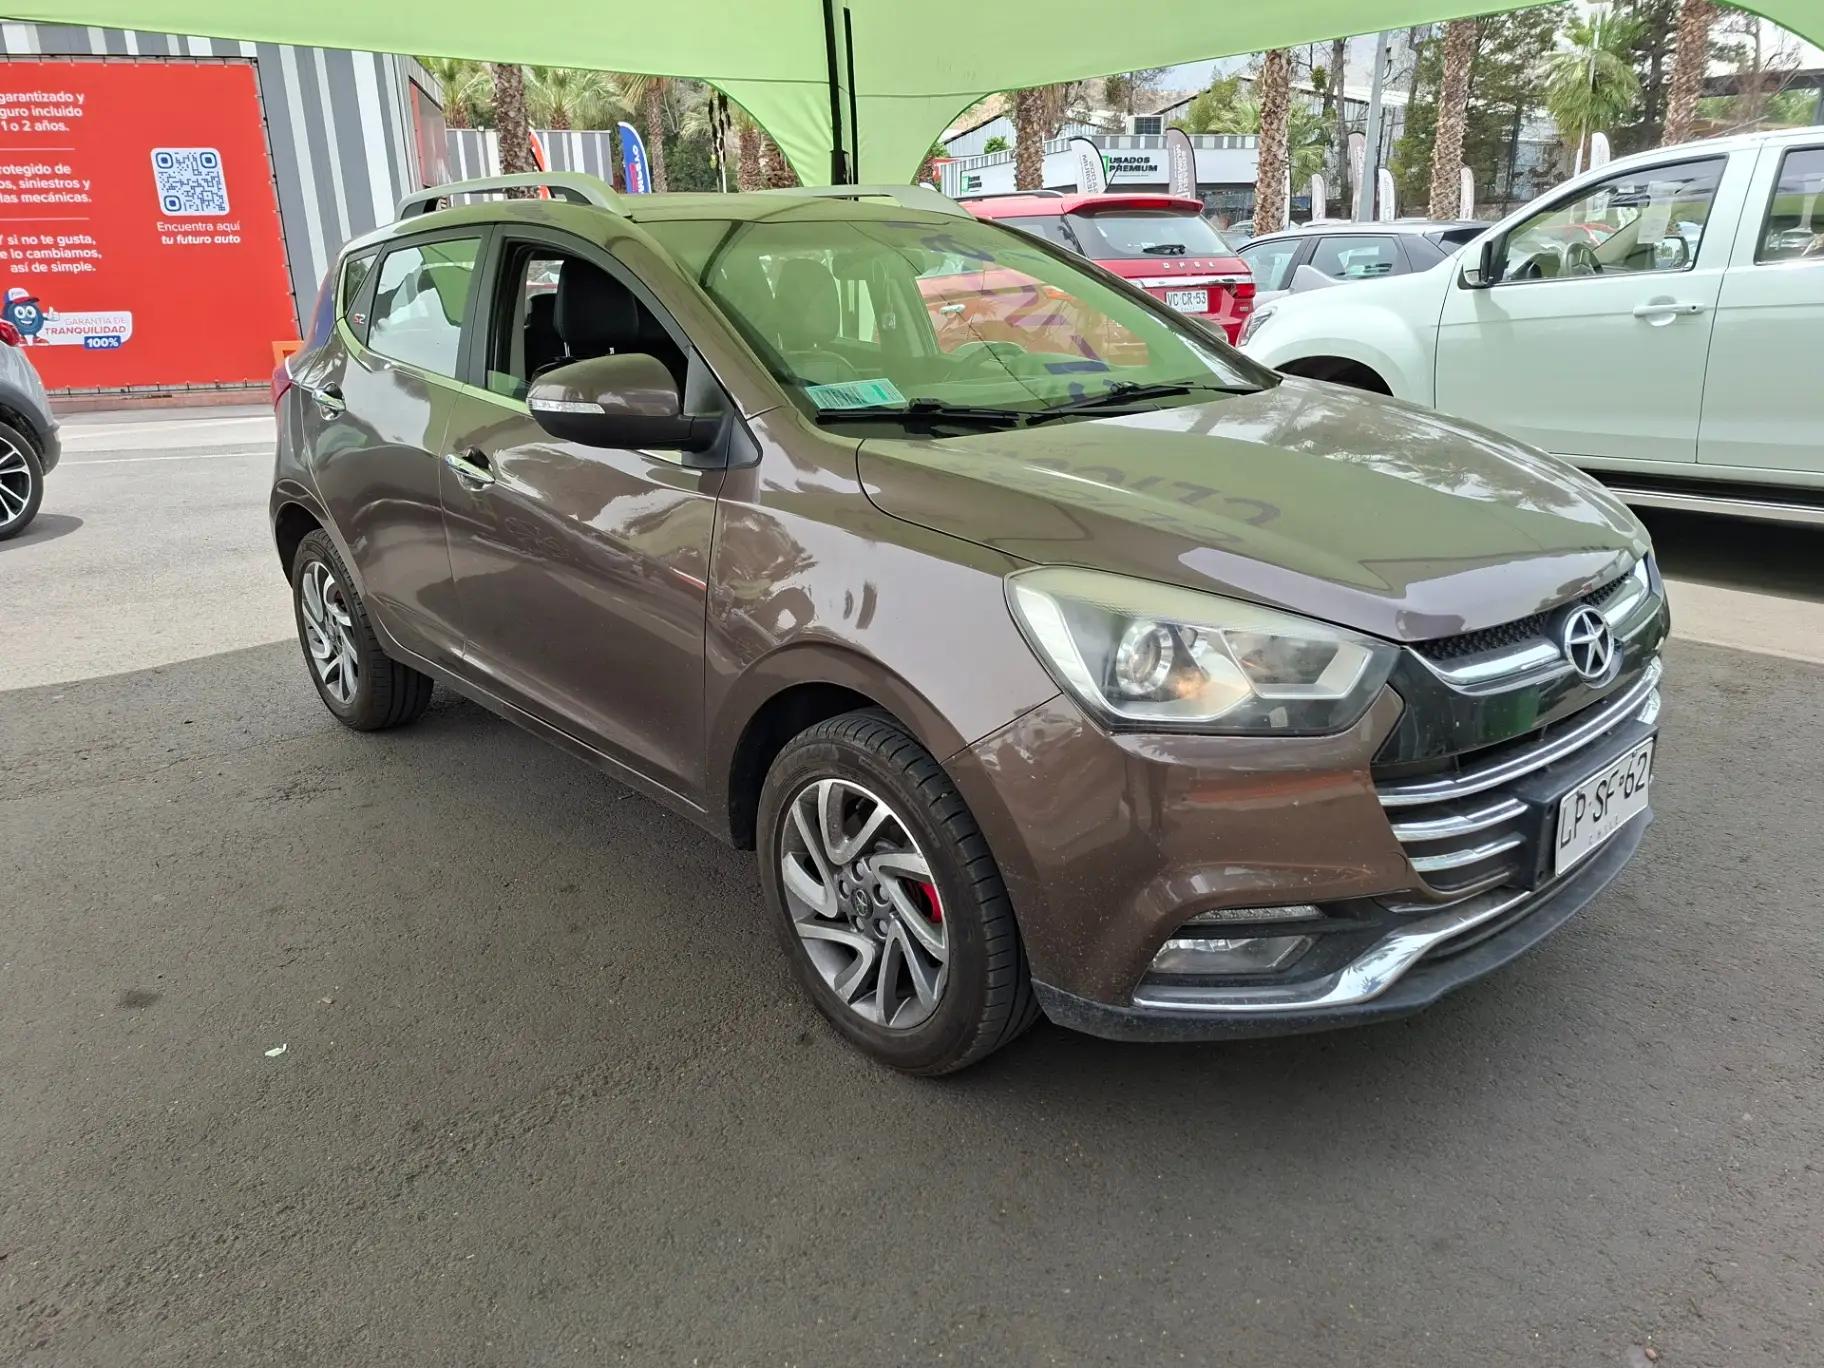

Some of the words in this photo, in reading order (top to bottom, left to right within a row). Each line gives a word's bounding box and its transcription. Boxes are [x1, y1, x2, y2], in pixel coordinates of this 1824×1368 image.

[75, 93, 85, 105] y
[31, 105, 83, 117] incluido
[10, 122, 20, 132] o
[22, 120, 32, 132] 2
[34, 119, 70, 132] años.
[1109, 156, 1151, 164] USADOS
[0, 163, 52, 177] otegido
[54, 163, 72, 175] de
[1109, 164, 1158, 172] PREMIUM
[18, 178, 81, 189] siniestros
[82, 179, 91, 191] y
[20, 191, 92, 203] mecánicas.
[156, 221, 214, 232] Encuentra
[216, 220, 240, 232] aquí
[7, 234, 19, 246] si
[21, 236, 39, 245] no
[40, 234, 55, 245] te
[56, 234, 97, 247] gusta,
[161, 234, 174, 245] tu
[176, 234, 212, 244] futuro
[214, 234, 241, 244] auto
[9, 248, 24, 260] lo
[26, 247, 103, 260] cambiamos,
[10, 261, 29, 273] así
[31, 261, 48, 273] de
[51, 261, 96, 274] simple.
[45, 325, 127, 336] TRANQUILIDAD
[86, 336, 120, 348] 100%
